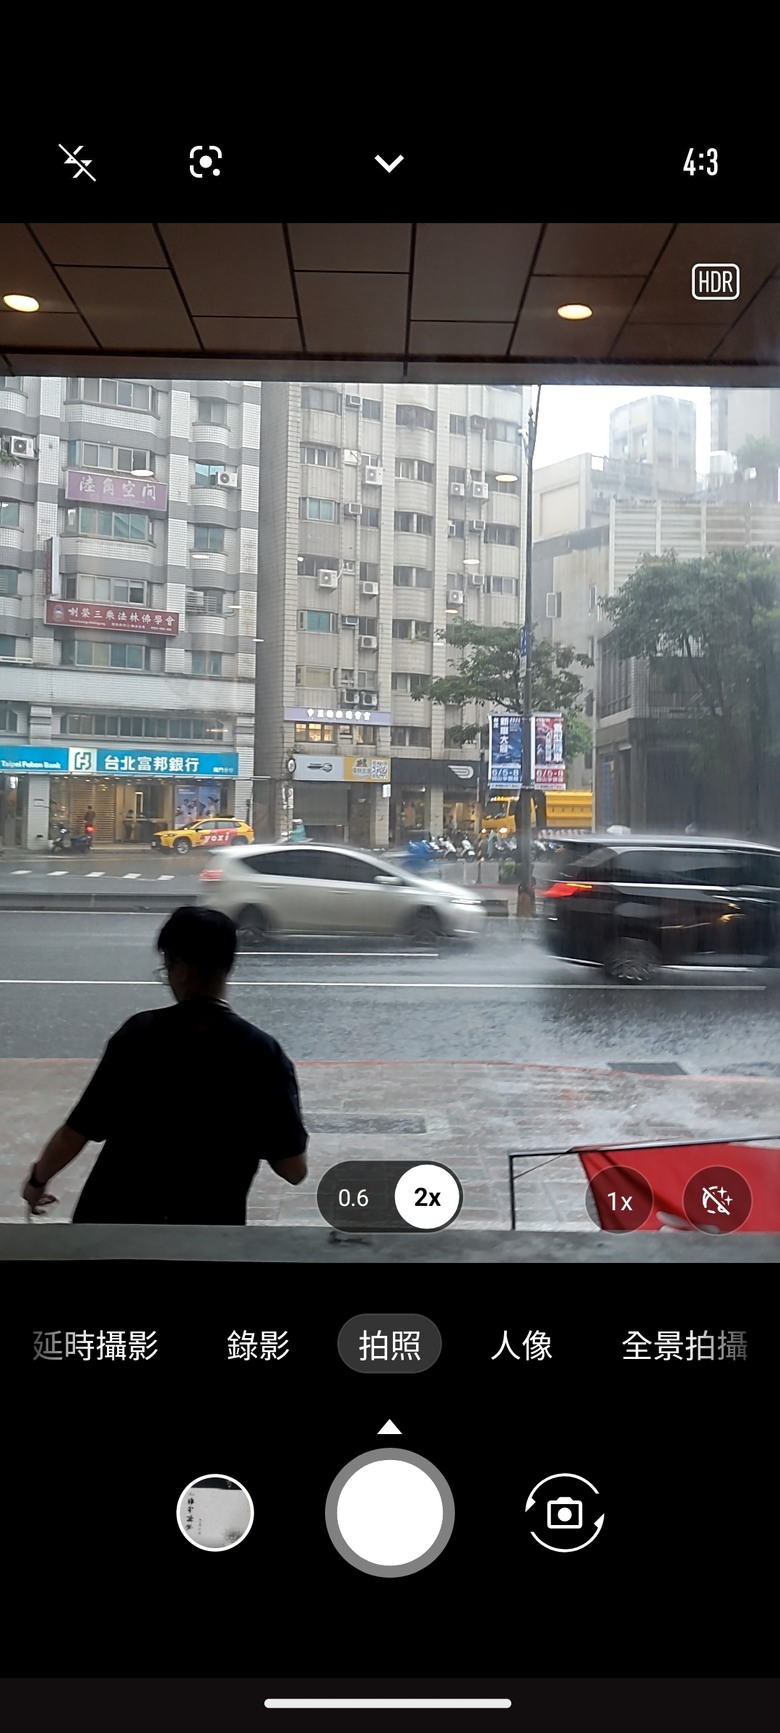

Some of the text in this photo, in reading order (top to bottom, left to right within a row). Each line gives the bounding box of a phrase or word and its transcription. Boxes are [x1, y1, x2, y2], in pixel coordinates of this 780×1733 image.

[1, 760, 21, 769] Taipei
[22, 761, 43, 769] Fubon
[104, 755, 199, 772] 台北富邦銀行
[204, 832, 230, 843] yoxi
